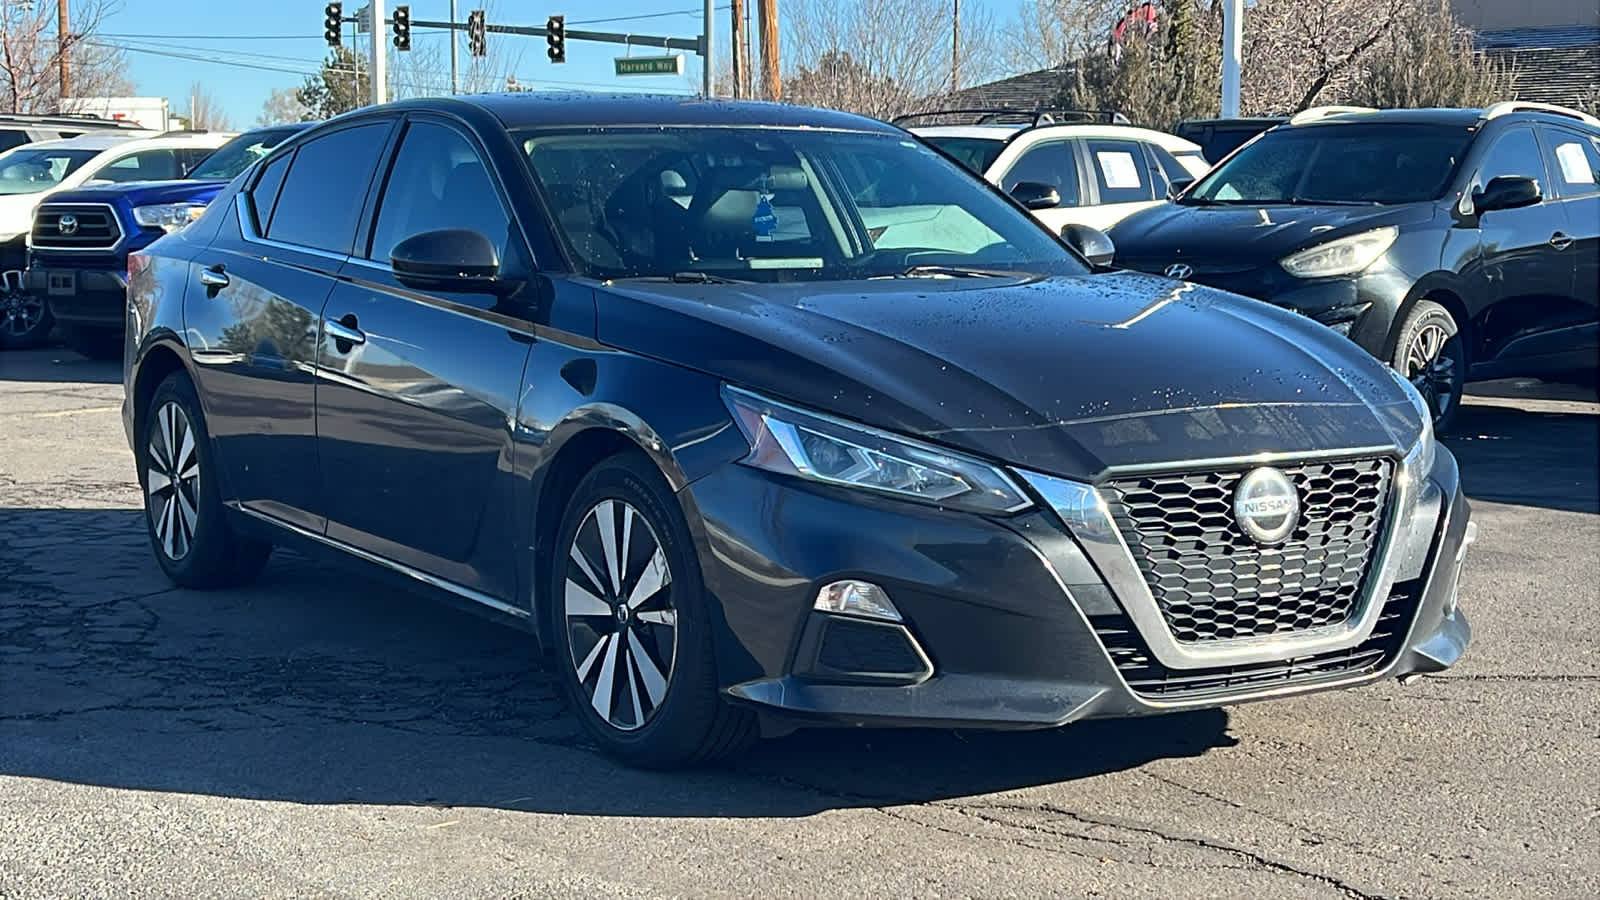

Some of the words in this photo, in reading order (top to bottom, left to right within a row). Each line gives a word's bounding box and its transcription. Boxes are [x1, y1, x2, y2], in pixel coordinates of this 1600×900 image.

[620, 62, 653, 72] Harvard
[657, 61, 673, 71] Way
[1244, 499, 1292, 513] NISSAN
